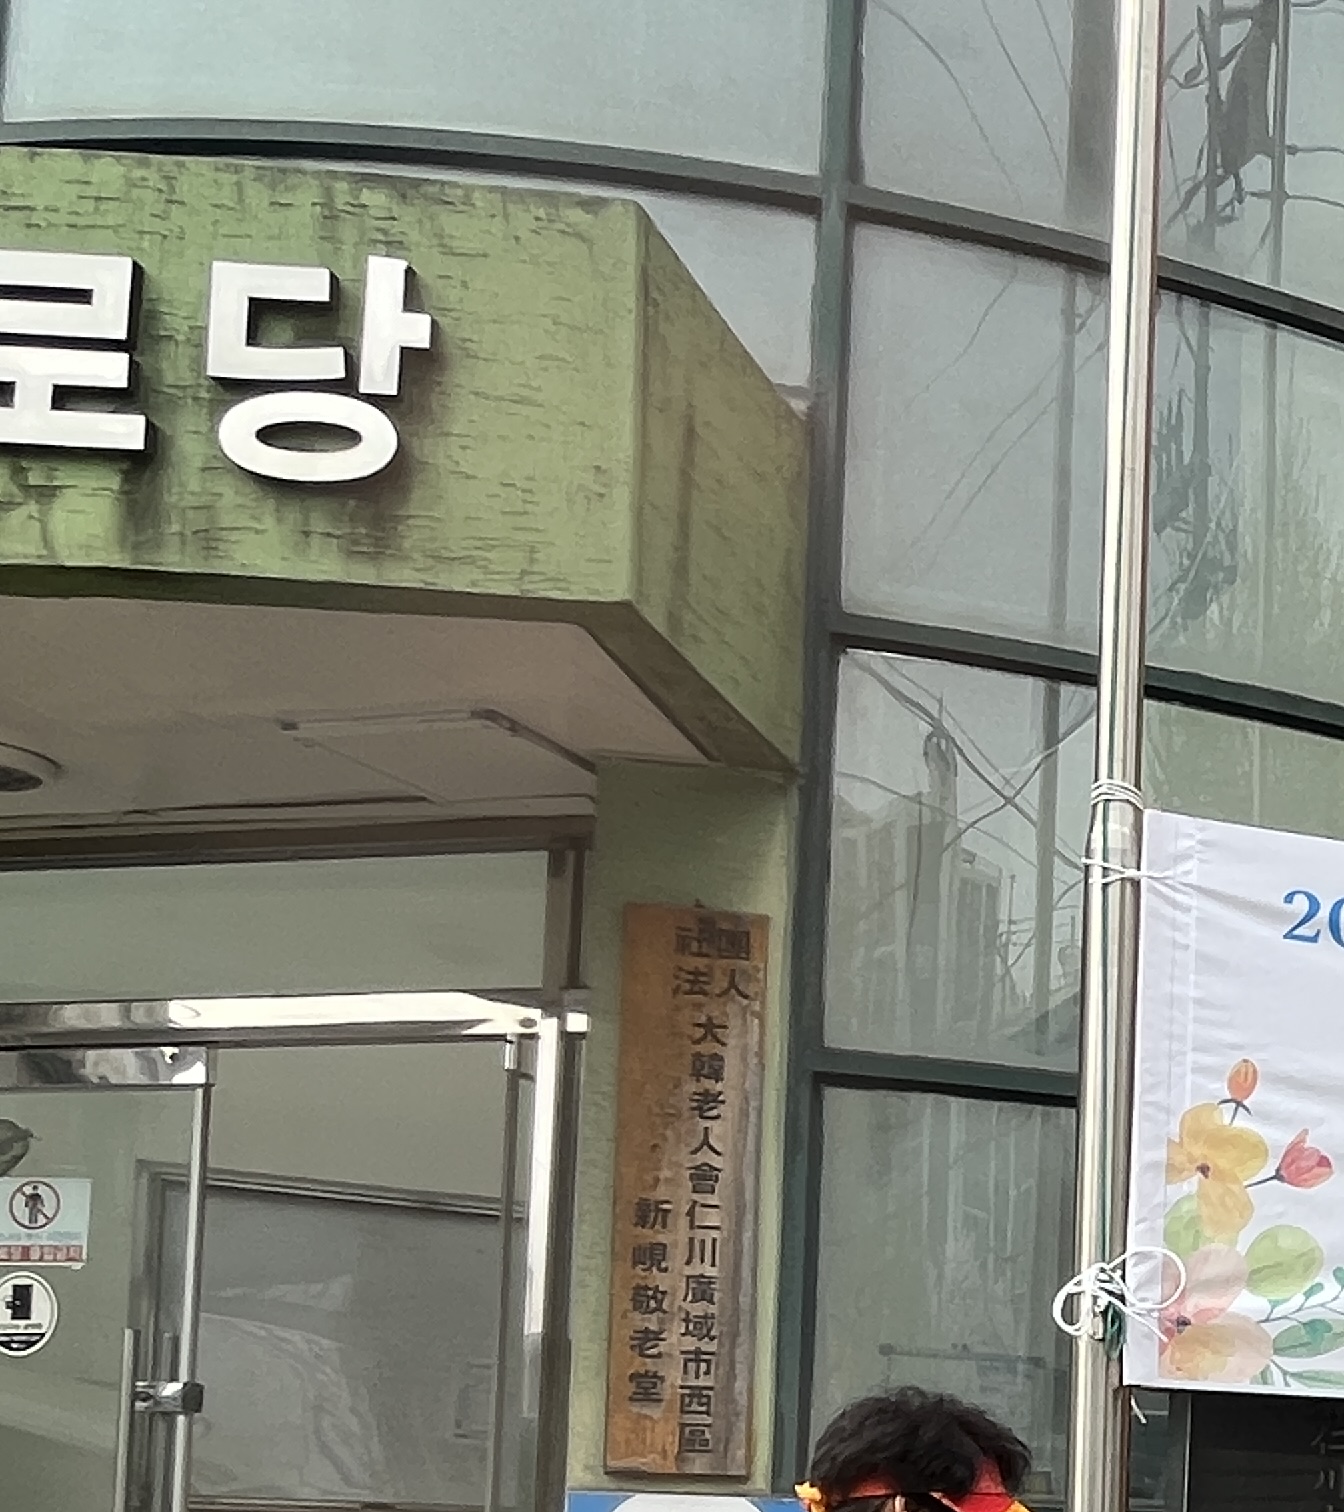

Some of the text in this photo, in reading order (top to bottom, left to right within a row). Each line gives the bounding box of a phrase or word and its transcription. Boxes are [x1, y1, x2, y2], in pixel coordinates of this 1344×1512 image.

[0, 250, 433, 485] 로당
[627, 1197, 673, 1404] 新峴敬老堂
